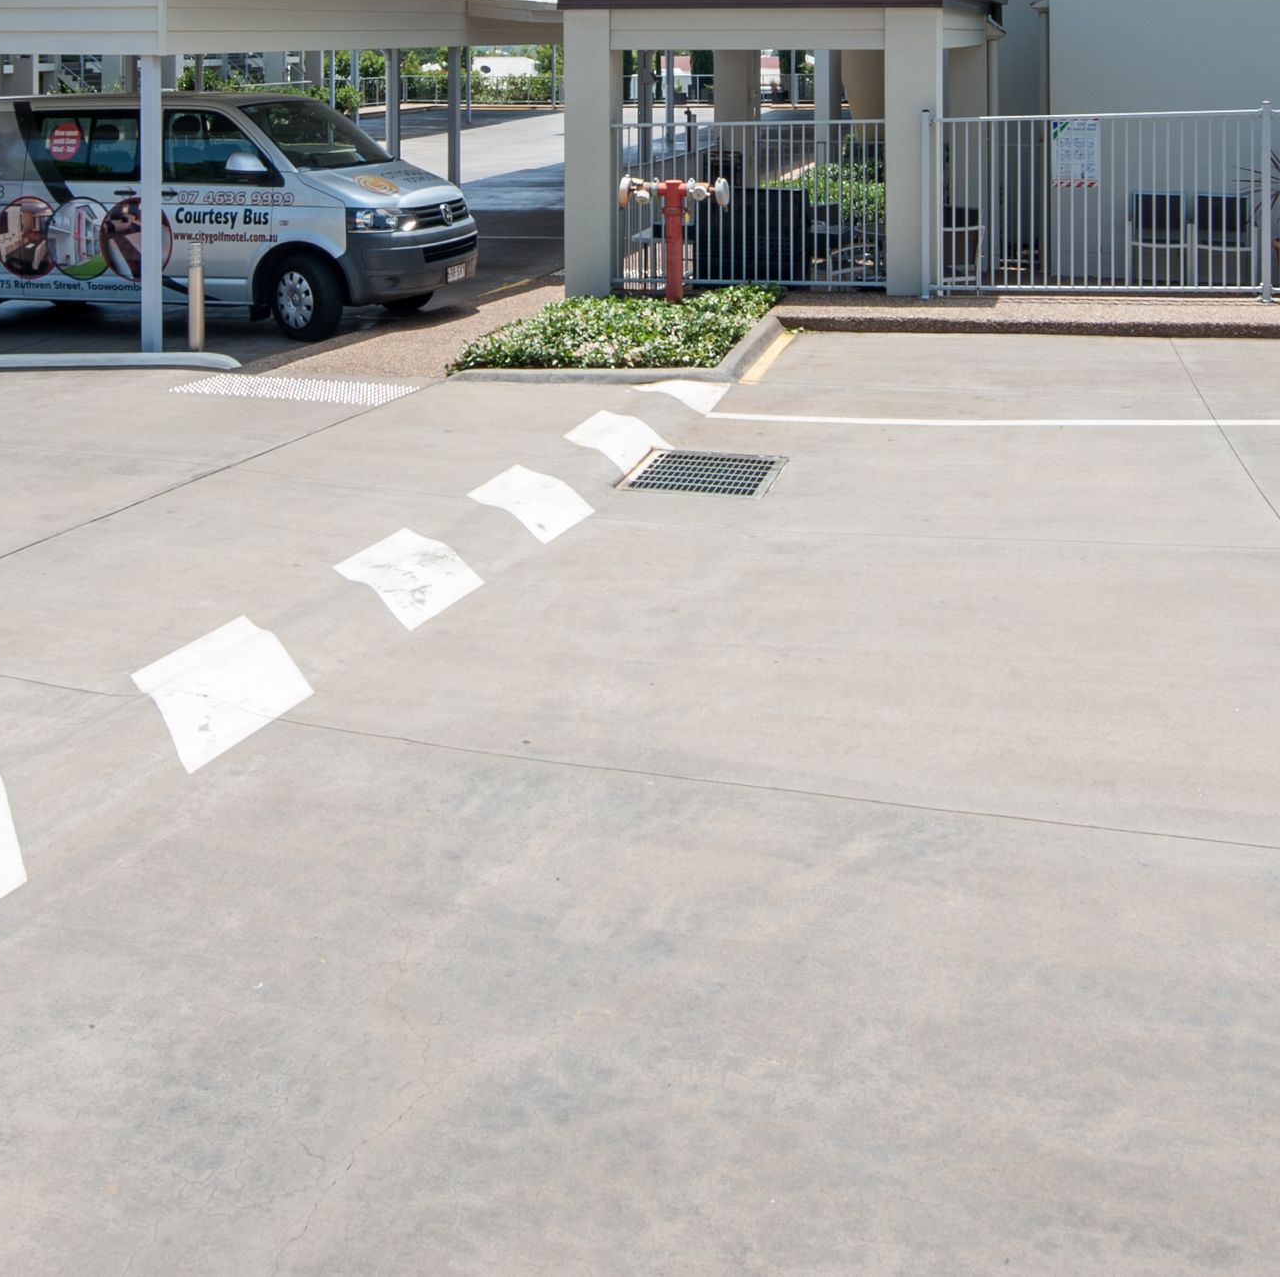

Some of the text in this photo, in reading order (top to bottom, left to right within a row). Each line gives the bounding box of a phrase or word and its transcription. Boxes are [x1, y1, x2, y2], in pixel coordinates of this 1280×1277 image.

[178, 190, 294, 207] 07 4636 9999
[175, 207, 269, 230] Courtesy Bus
[173, 230, 278, 244] www.citygolfmotel.com.au
[14, 280, 52, 290] Ruthven
[87, 282, 142, 292] Toowoomb
